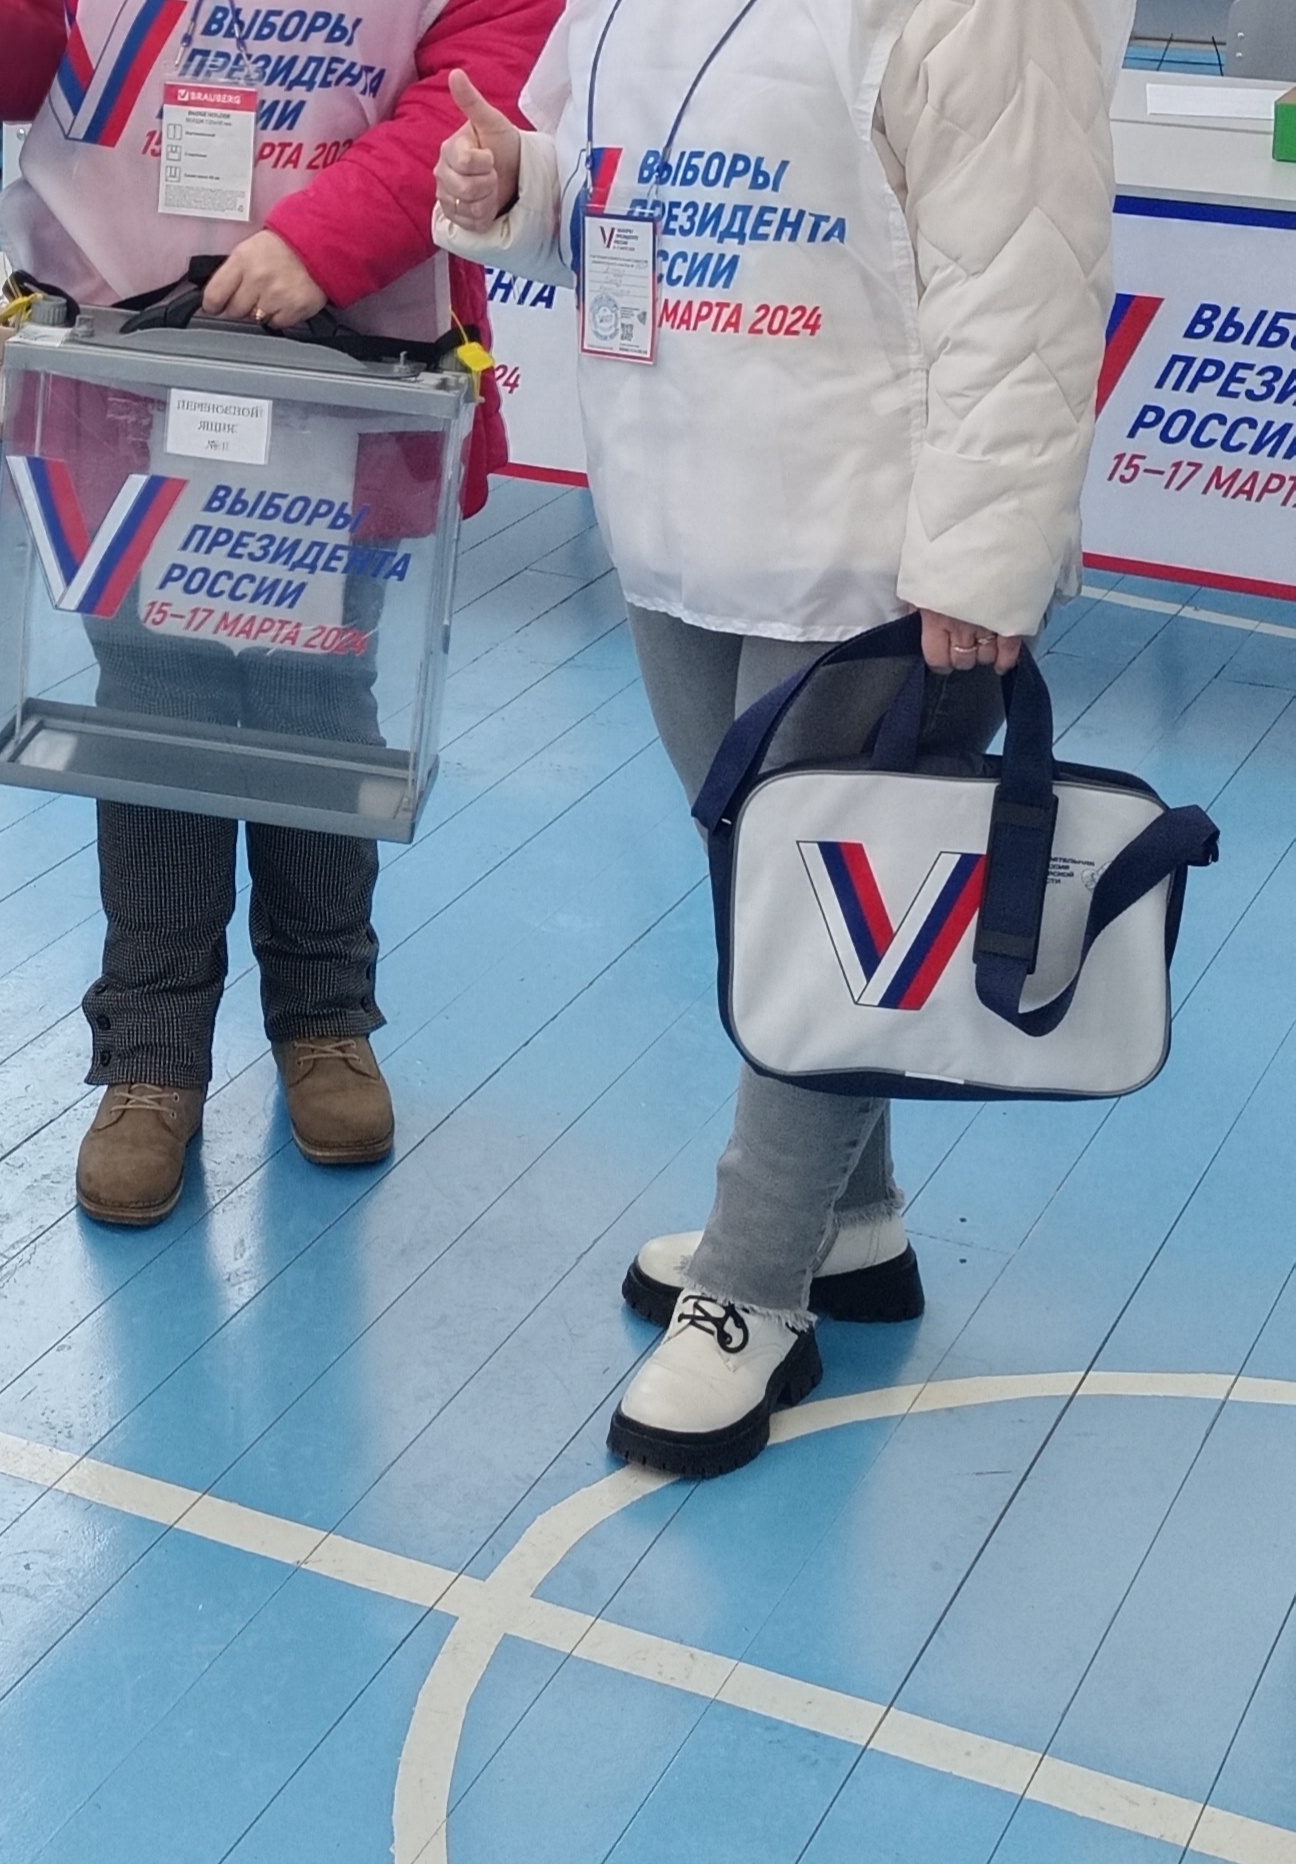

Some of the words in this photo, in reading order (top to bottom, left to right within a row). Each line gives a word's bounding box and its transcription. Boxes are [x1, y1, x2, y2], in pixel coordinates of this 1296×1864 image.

[201, 5, 363, 47] ВЫБОРЫ
[177, 48, 387, 99] ПРЕЗИДЕНТА
[190, 91, 241, 104] BRAUBERG
[254, 141, 304, 169] РТА
[637, 149, 791, 193] ВЫБОРЫ
[657, 298, 743, 334] МАРТА
[747, 303, 823, 337] 2024
[1182, 303, 1296, 352] ВЫБ
[197, 420, 236, 434] ЯЩИК
[201, 484, 371, 533] ВЫБОРЫ
[1201, 465, 1296, 509] МАРТ
[179, 523, 412, 583] ПРЕЗИДЕНТА
[157, 563, 308, 610] РОССИИ
[212, 611, 303, 647] МАРТА
[304, 624, 369, 657] 2024
